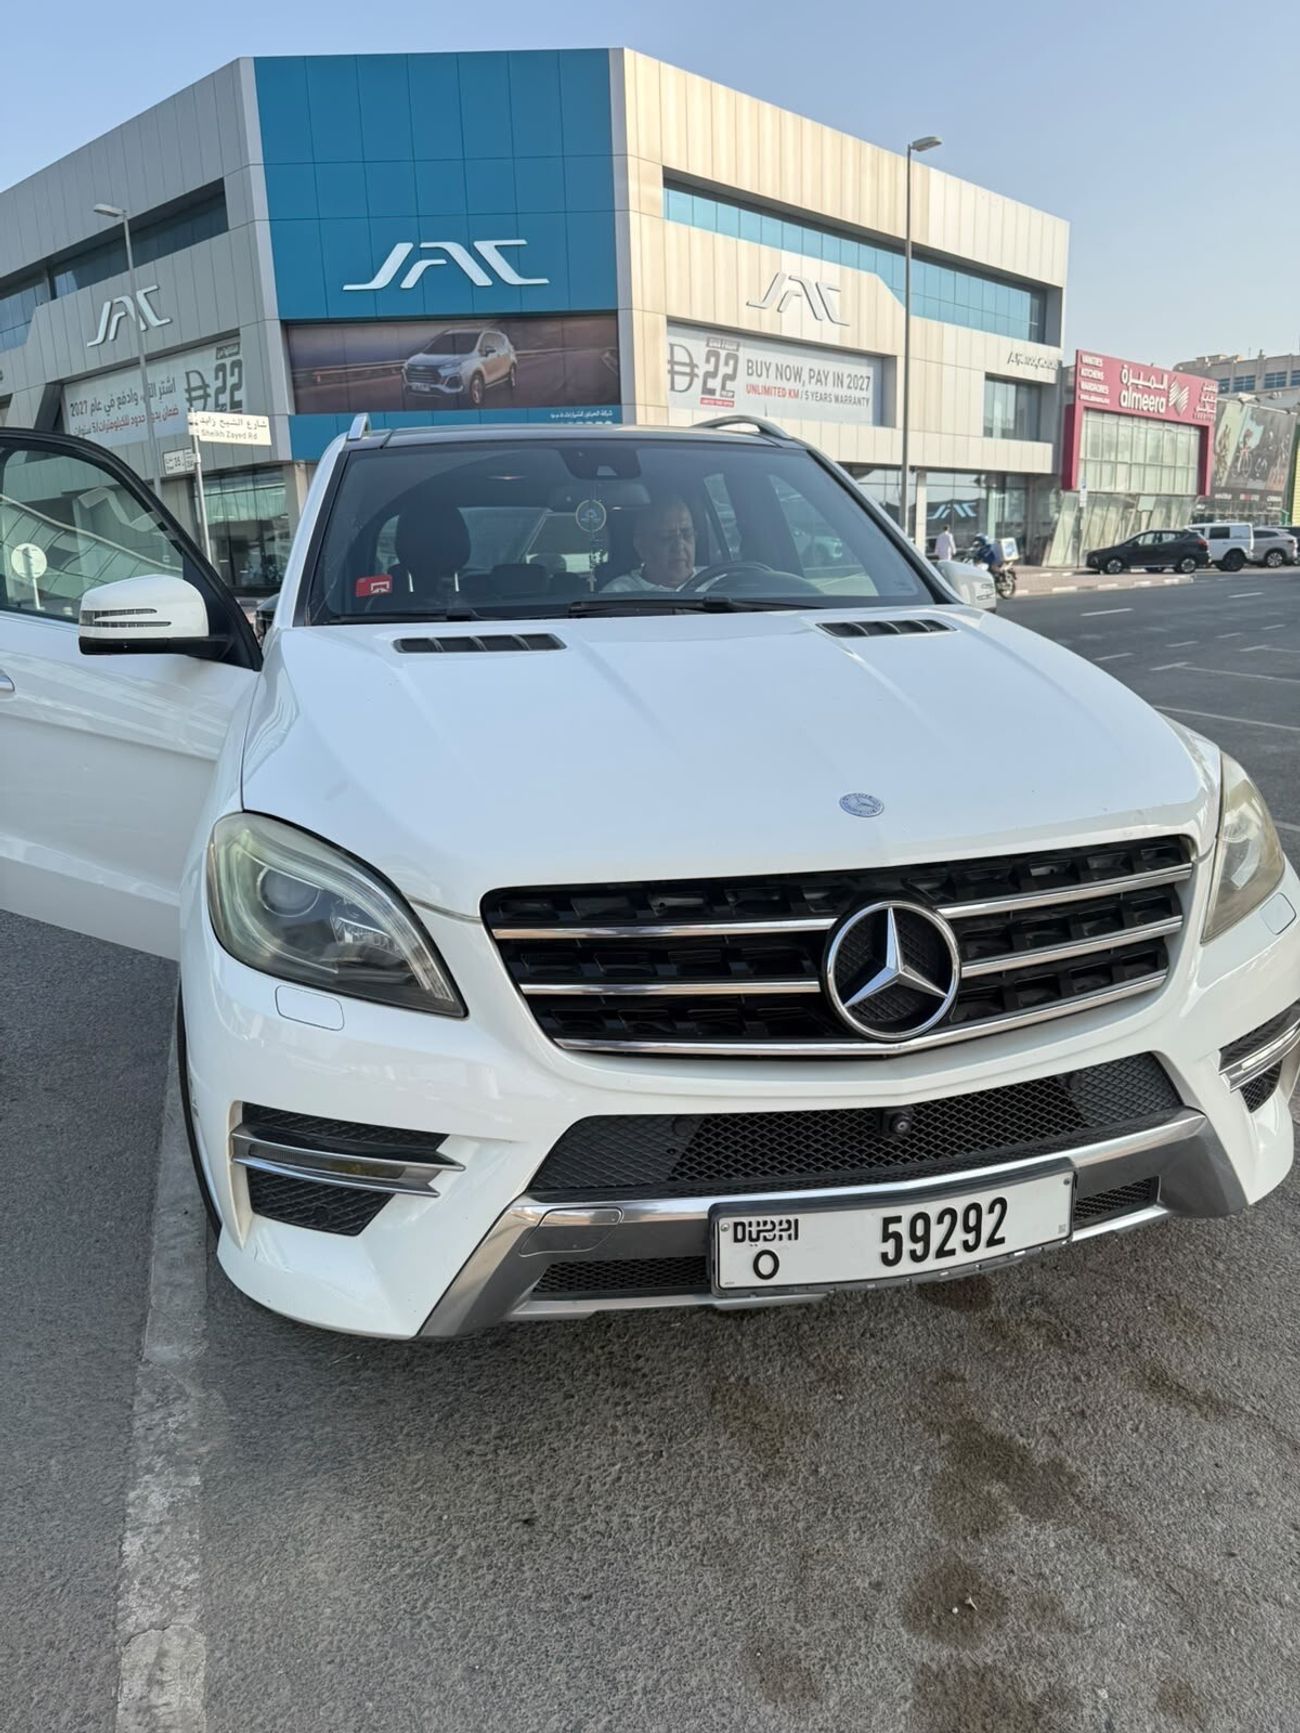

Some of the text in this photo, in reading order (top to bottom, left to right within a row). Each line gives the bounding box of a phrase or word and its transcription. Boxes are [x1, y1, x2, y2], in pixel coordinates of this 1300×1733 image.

[343, 239, 550, 291] JAC
[746, 272, 850, 327] JAC
[87, 284, 173, 347] JAC
[214, 359, 243, 412] 22
[701, 349, 739, 398] 22
[746, 358, 871, 393] BUY NOW, PAY IN 2027
[1121, 364, 1168, 391] الميرة
[70, 400, 88, 417] 2027
[104, 394, 116, 417] في
[745, 383, 787, 398] UNLIMITED
[788, 388, 800, 400] KM
[804, 389, 810, 401] 5
[811, 391, 833, 404] YEARS
[833, 394, 870, 408] WARRANTY
[1120, 386, 1166, 414] almeera
[201, 429, 259, 441] Sheikh Zayed Rd
[219, 418, 244, 429] الشيخ
[246, 419, 267, 431] شارع
[880, 1196, 1009, 1268] 59292
